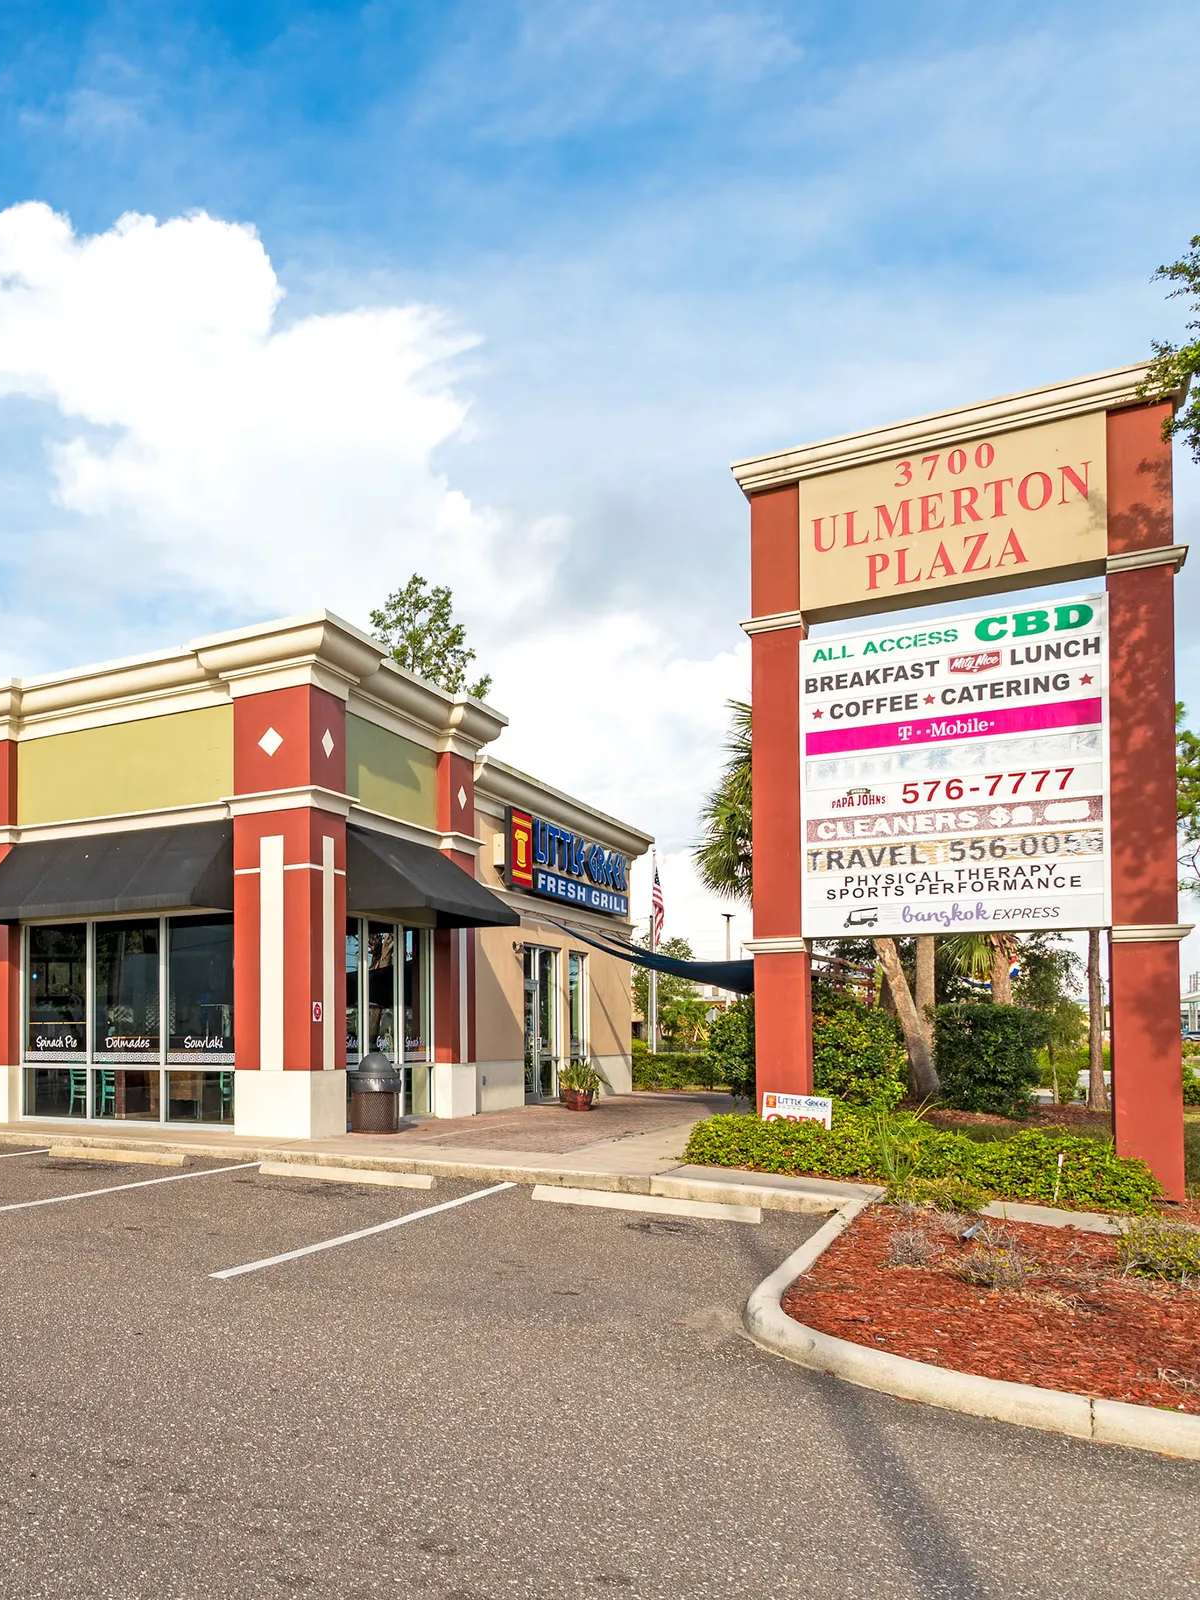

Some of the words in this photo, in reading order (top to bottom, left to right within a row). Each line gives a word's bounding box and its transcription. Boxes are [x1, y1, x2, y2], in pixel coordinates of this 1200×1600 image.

[894, 443, 995, 487] 3700
[811, 461, 1092, 552] ULMERTON
[865, 527, 1029, 591] PLAZA
[812, 645, 854, 663] ALL
[862, 628, 959, 656] ACCESS
[974, 604, 1094, 642] CBD
[1010, 636, 1101, 666] LUNCH
[805, 660, 940, 694] BREAKFAST
[829, 693, 918, 720] COFFEE
[941, 673, 1070, 705] CATERING
[901, 767, 1075, 804] 576-7777
[831, 796, 854, 809] PAPA
[857, 794, 886, 806] JOHNS
[817, 807, 979, 840] CLEANERS
[535, 817, 586, 878] LITTLE
[587, 842, 628, 892] GREEK
[807, 845, 927, 871] TRAVEL
[826, 886, 905, 900] SPORTS
[915, 875, 1082, 896] PERFORMANCE
[844, 871, 945, 887] PHYSICAL
[955, 863, 1057, 881] THERAPY
[537, 872, 586, 902] FRESH
[591, 890, 628, 914] GRILL
[902, 902, 990, 928] bangkok
[992, 906, 1061, 920] EXPRESS
[36, 1036, 64, 1050] Spinach
[65, 1035, 77, 1048] Pie
[105, 1037, 150, 1049] Dolmades
[184, 1036, 224, 1049] Souvlaki
[778, 1096, 801, 1106] LITTLE
[805, 1098, 829, 1108] GREEK
